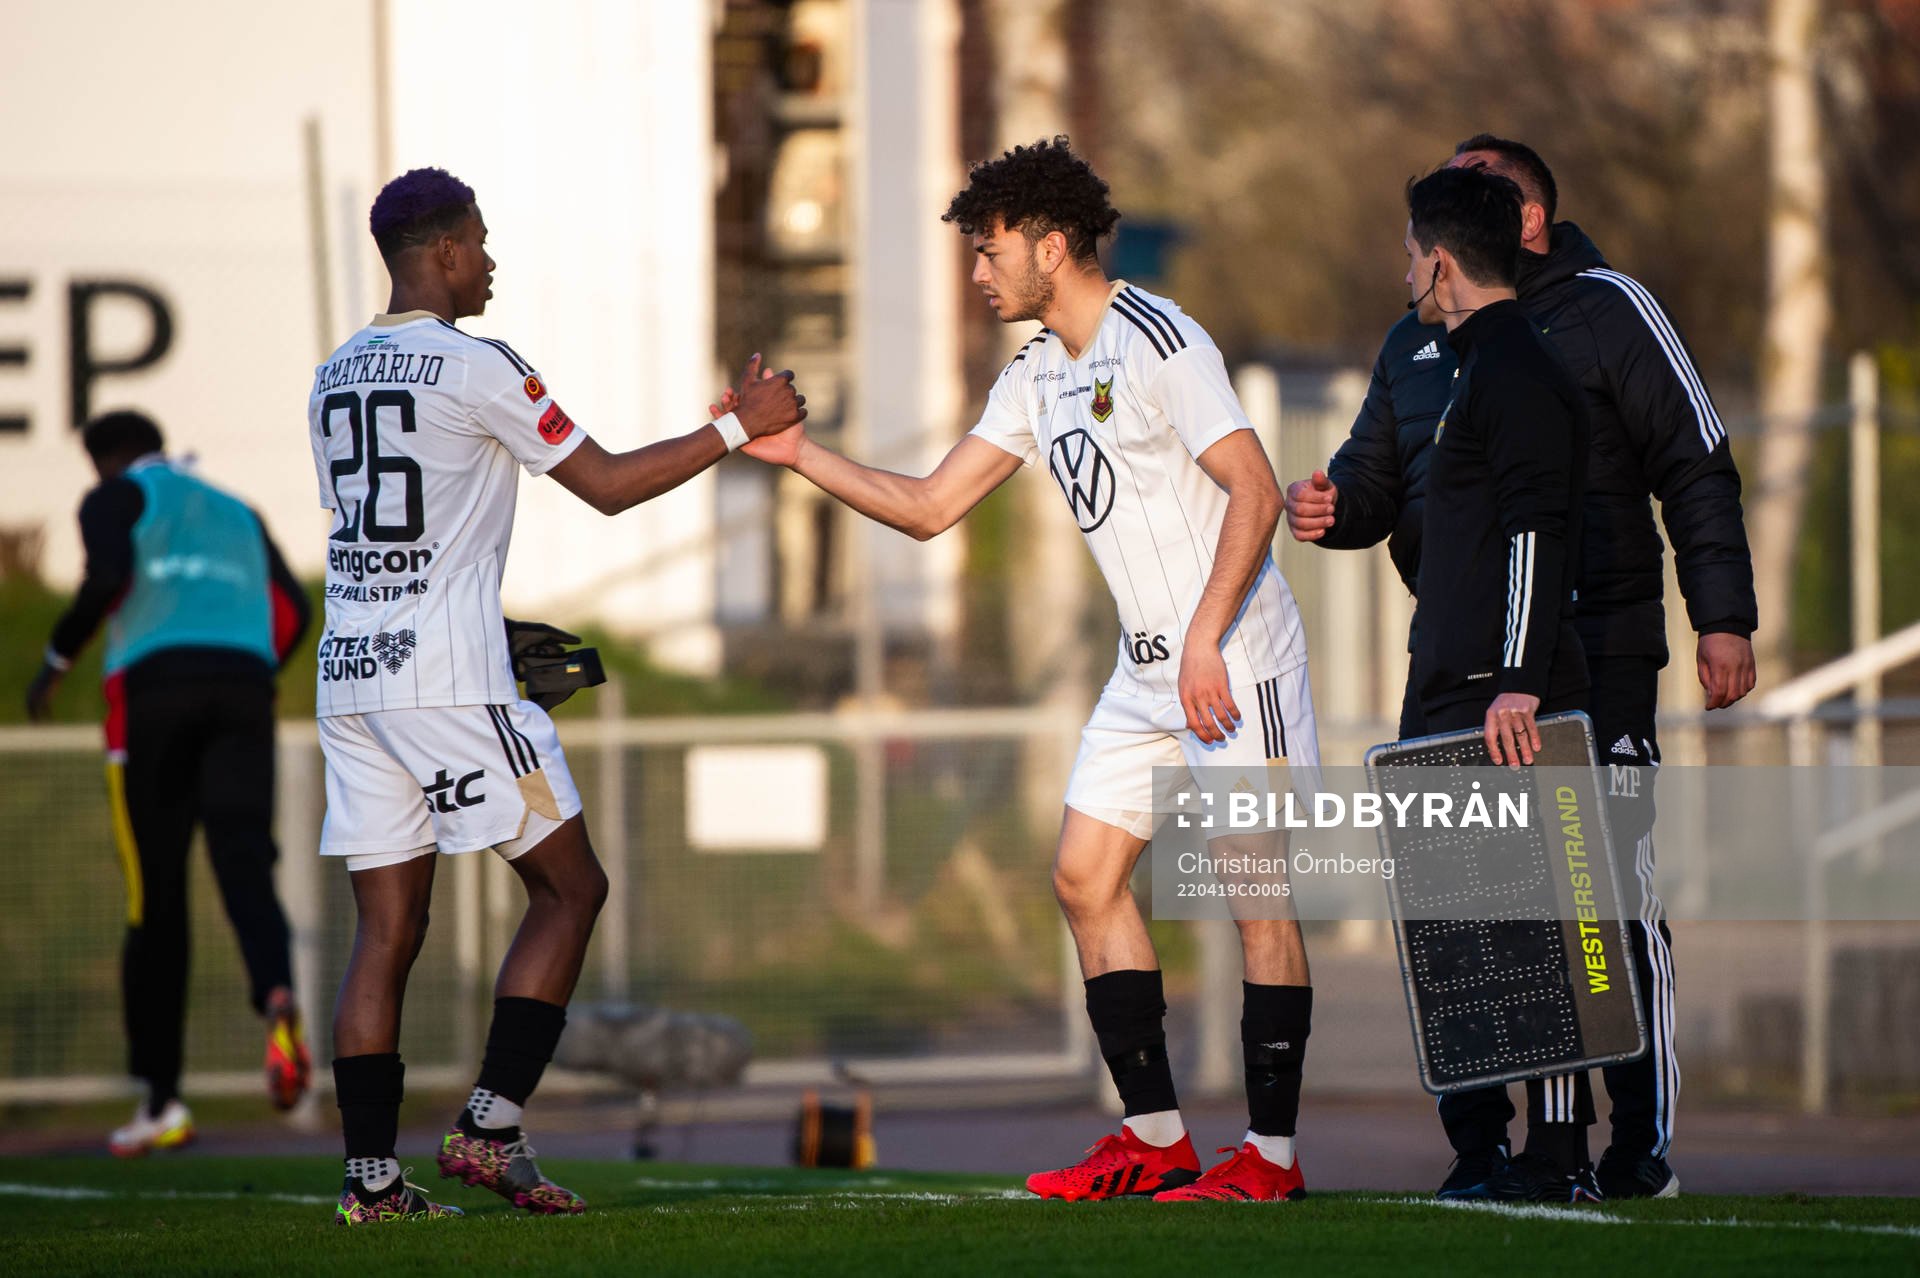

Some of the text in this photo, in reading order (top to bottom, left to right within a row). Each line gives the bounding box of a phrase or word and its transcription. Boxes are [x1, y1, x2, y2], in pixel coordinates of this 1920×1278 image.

[318, 353, 444, 395] AMATKARIJO
[321, 389, 424, 542] 26
[341, 578, 429, 602] HALLSTRMS
[323, 657, 377, 681] SUND
[1611, 746, 1638, 757] adidas
[1609, 764, 1641, 797] MP
[1556, 785, 1611, 994] WESTERSTRAND
